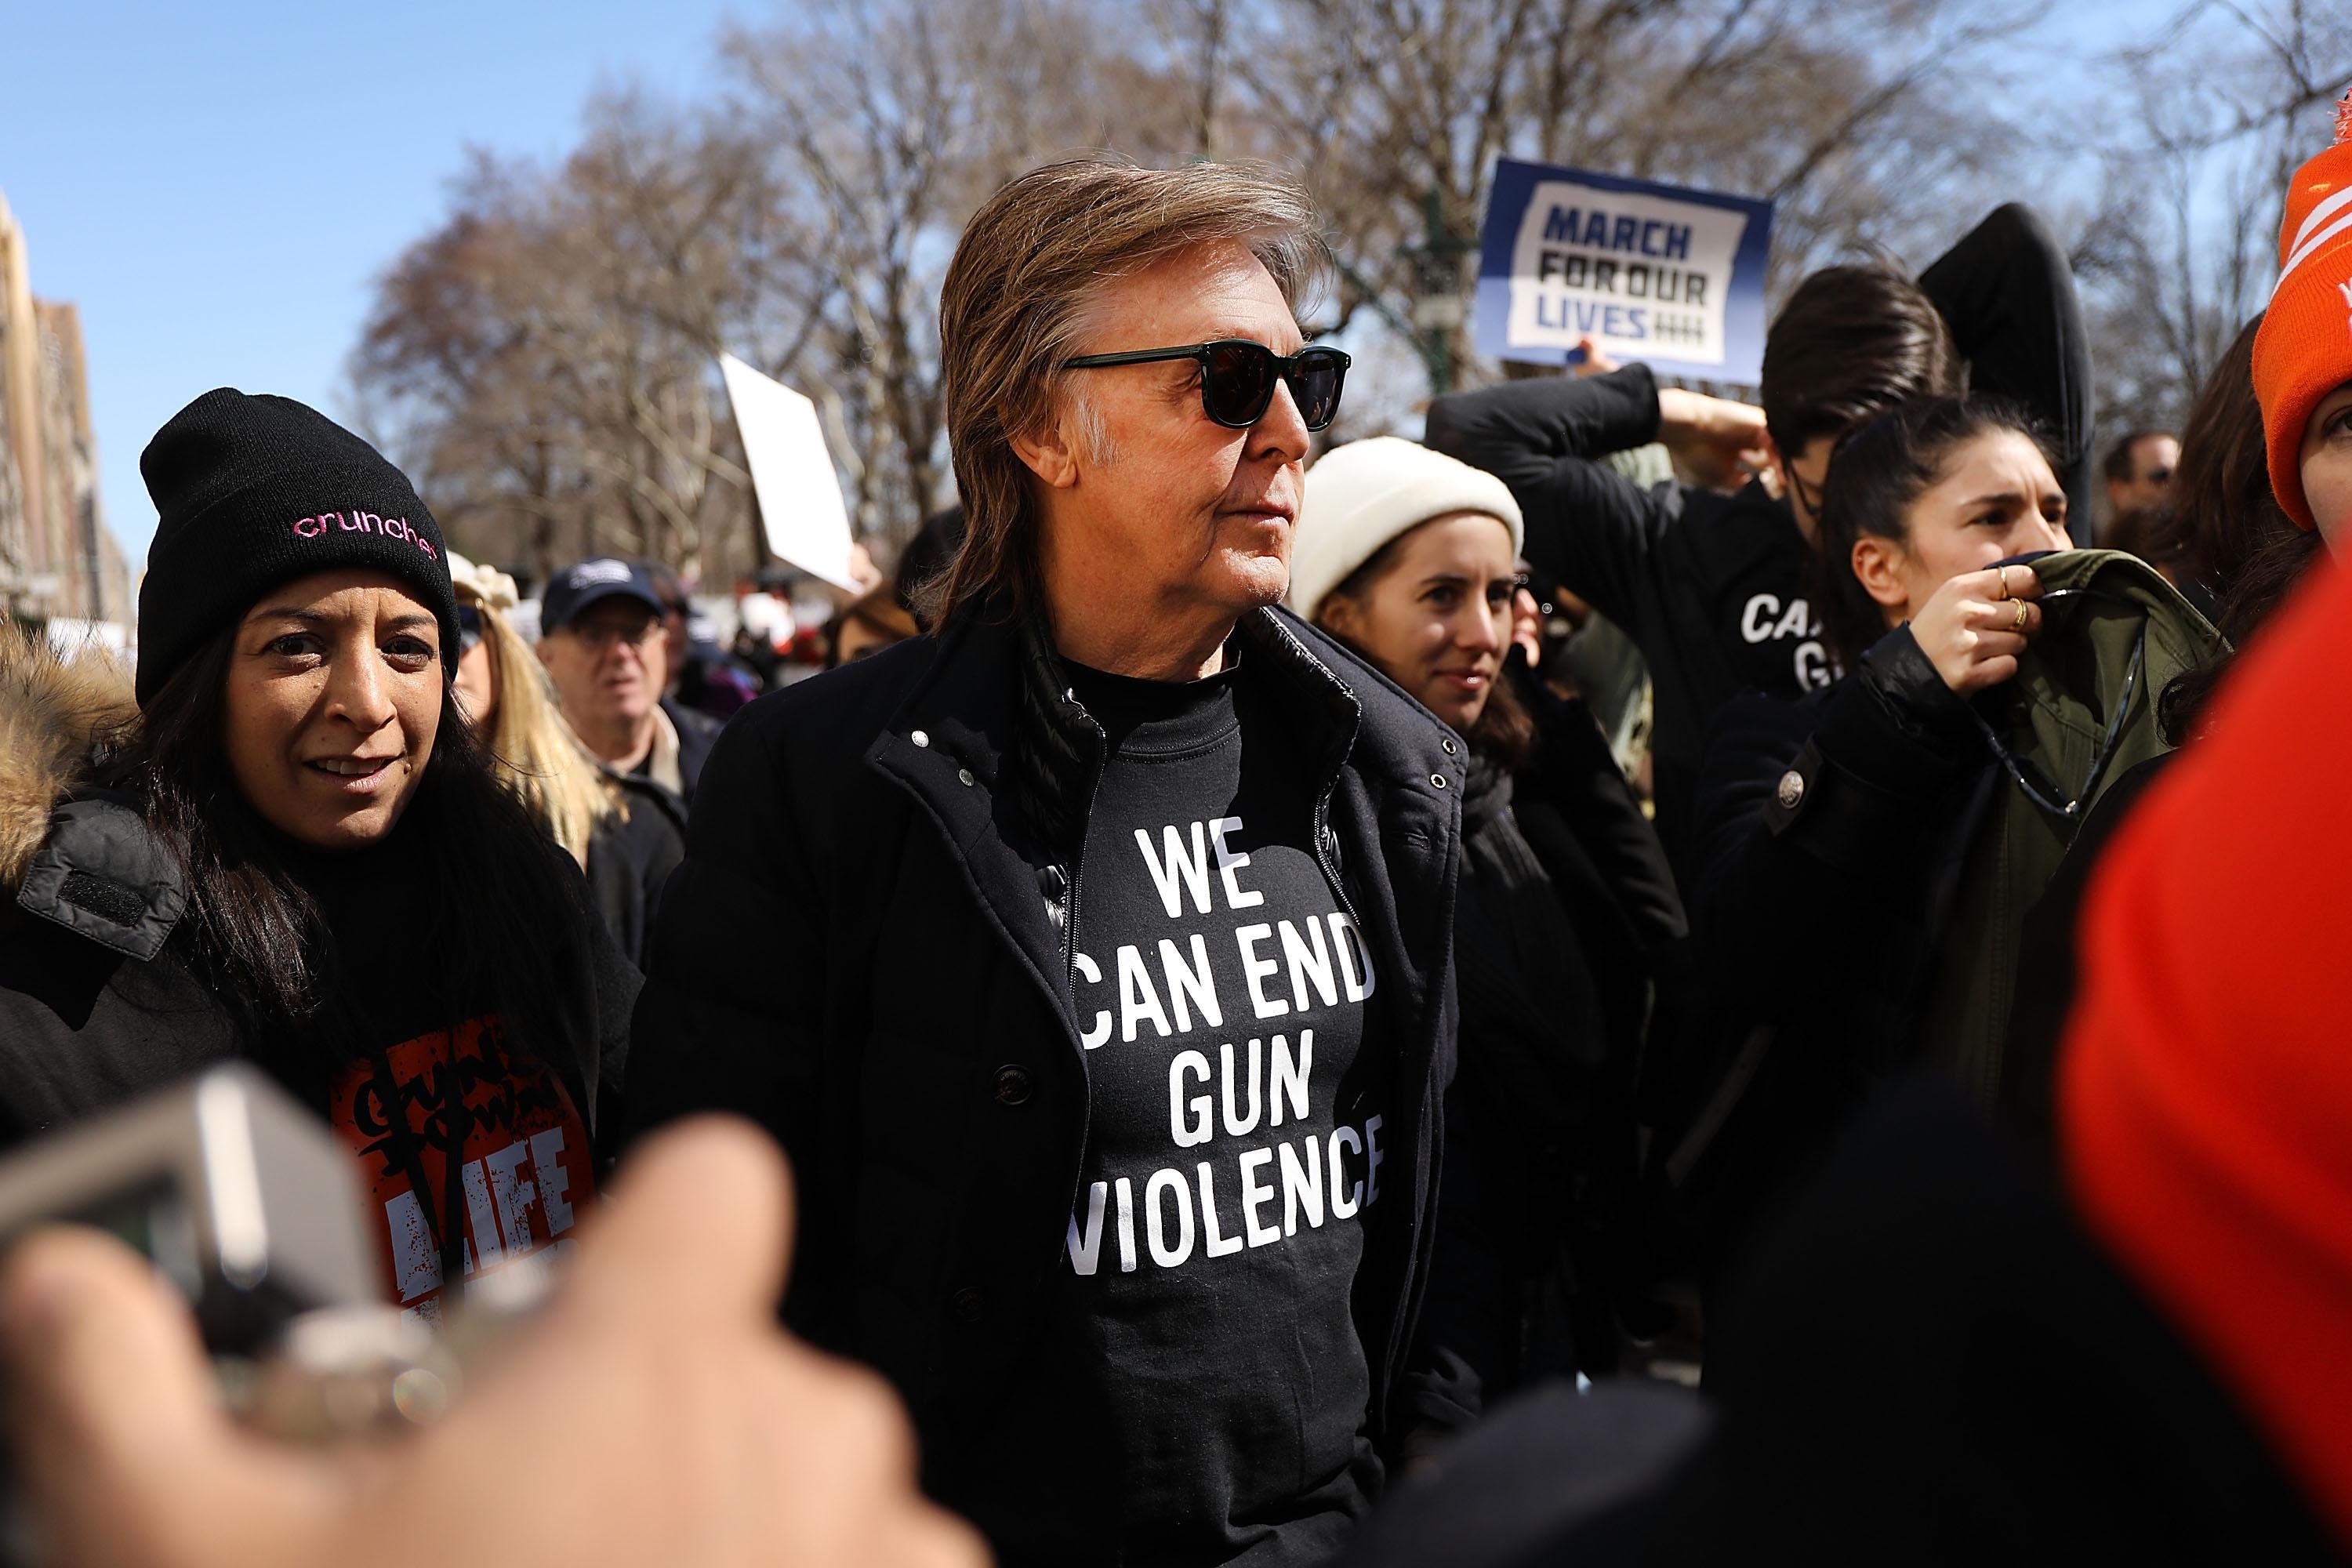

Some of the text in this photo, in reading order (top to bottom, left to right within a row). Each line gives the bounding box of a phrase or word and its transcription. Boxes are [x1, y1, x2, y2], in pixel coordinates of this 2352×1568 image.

[1538, 250, 1708, 306] FOR OUR
[1544, 205, 1693, 260] MARCH
[1537, 296, 1646, 339] LIVES
[1741, 593, 1823, 644] CA
[1134, 816, 1265, 919] WE
[1072, 912, 1376, 1050] CAN END
[1169, 1029, 1314, 1148] GUN
[385, 1126, 575, 1303] LIFE
[1066, 1114, 1384, 1276] VIOLENCE
